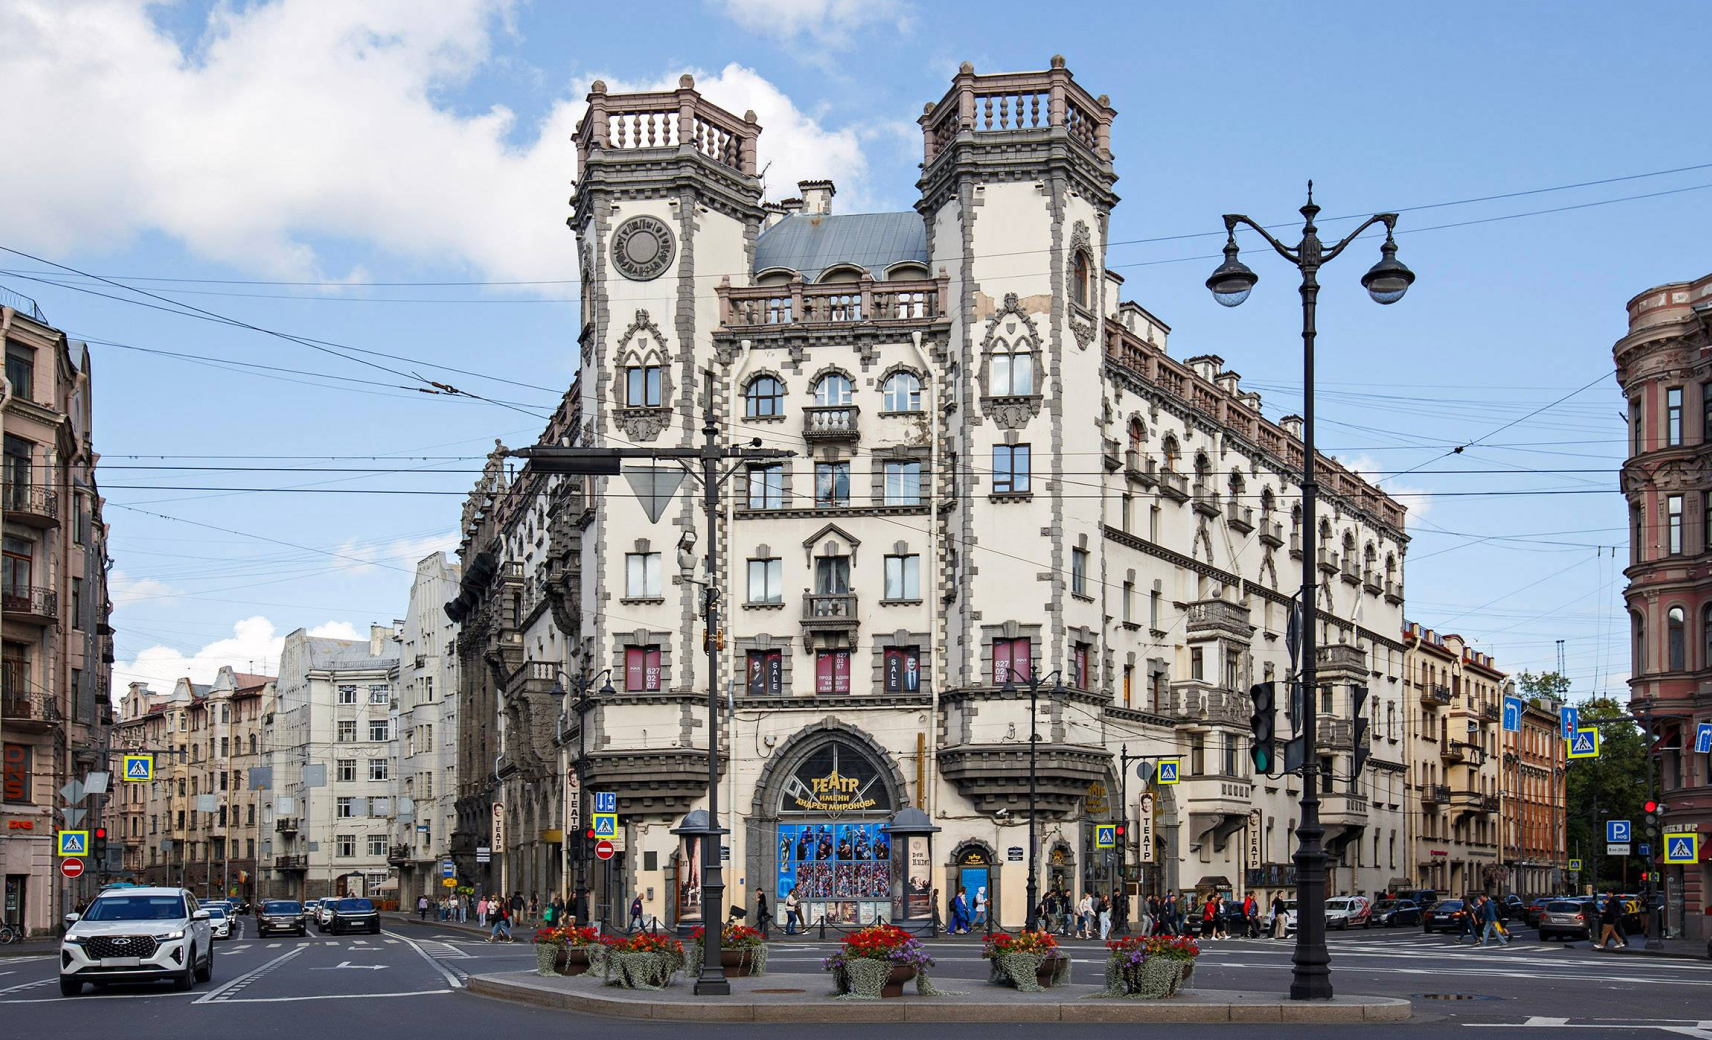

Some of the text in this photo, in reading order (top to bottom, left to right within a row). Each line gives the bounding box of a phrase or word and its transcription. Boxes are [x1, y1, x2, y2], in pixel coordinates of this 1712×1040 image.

[5, 745, 25, 799] DNS
[811, 770, 859, 793] ТЕАТР
[570, 792, 579, 831] ТЕАТР
[795, 798, 876, 811] АНДРЕЯ МИРОНОВА
[1143, 818, 1151, 861] ТЕАТР
[1684, 823, 1698, 831] UP
[1250, 830, 1258, 868] ТЕАТР
